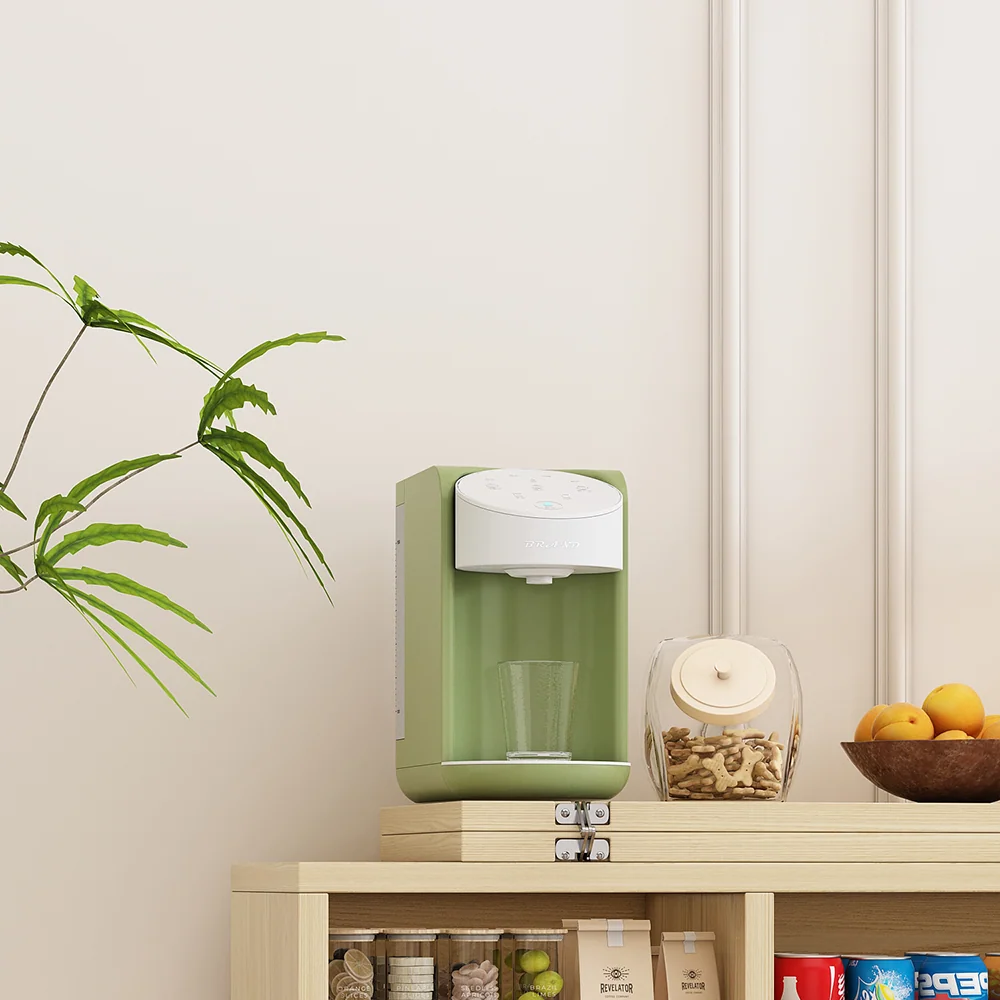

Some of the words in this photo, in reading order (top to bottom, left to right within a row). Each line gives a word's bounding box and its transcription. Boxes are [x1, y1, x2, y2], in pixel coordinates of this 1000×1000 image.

[524, 540, 580, 548] BRAND
[600, 983, 634, 994] REVELATOR
[681, 982, 706, 991] REVELATOR
